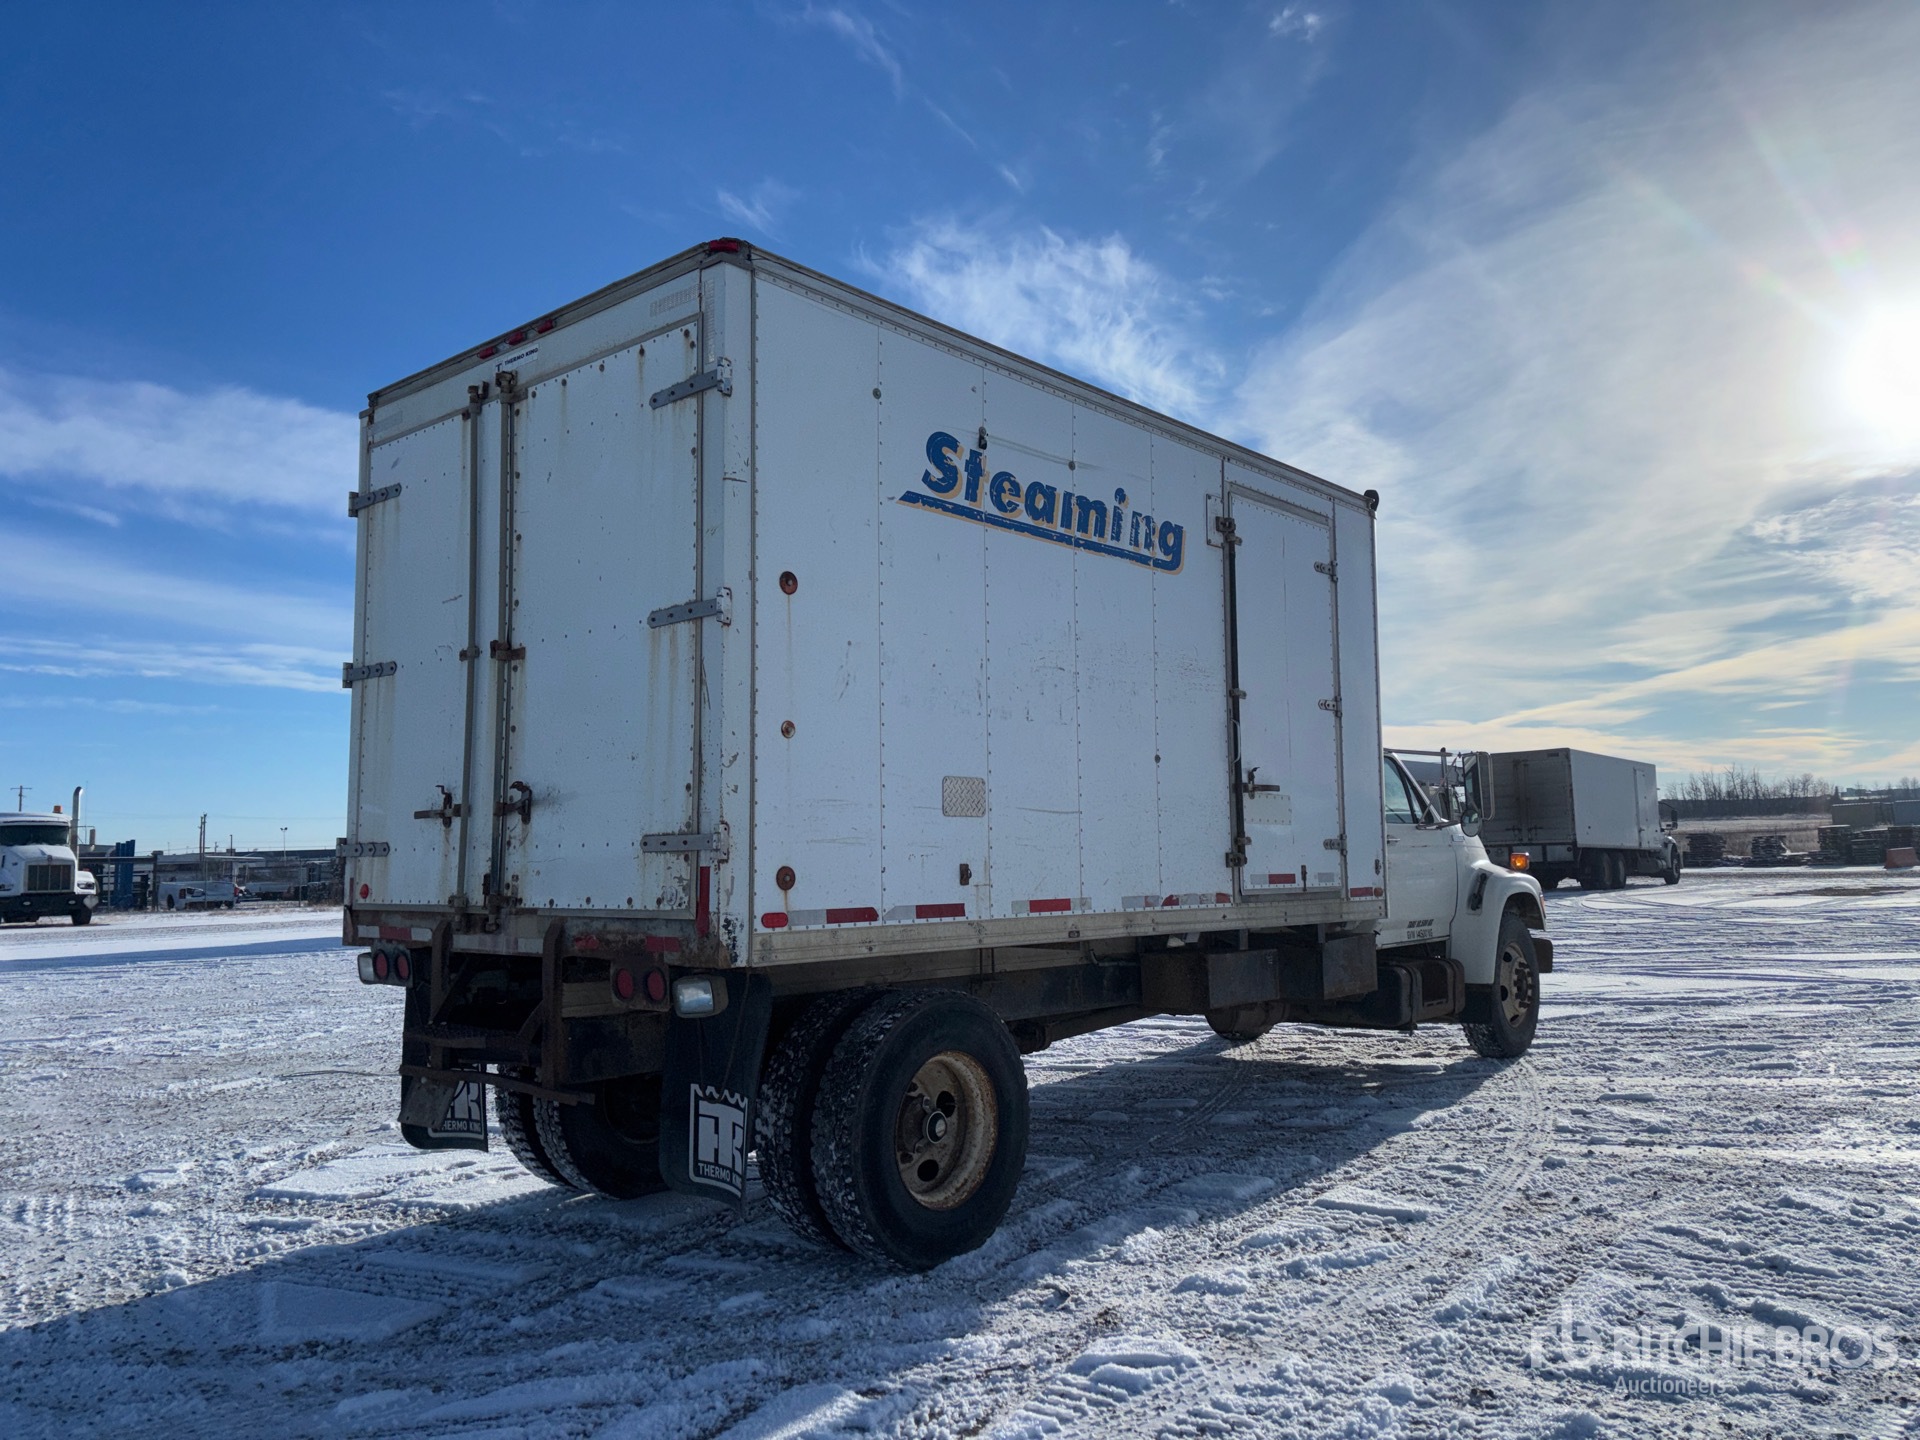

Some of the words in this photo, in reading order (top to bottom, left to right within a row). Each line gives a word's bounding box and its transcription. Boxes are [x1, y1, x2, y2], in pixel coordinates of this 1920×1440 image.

[504, 353, 525, 366] THERMO
[921, 431, 1186, 575] Steaming
[441, 1120, 468, 1131] HERMO
[698, 1162, 731, 1182] THERMO
